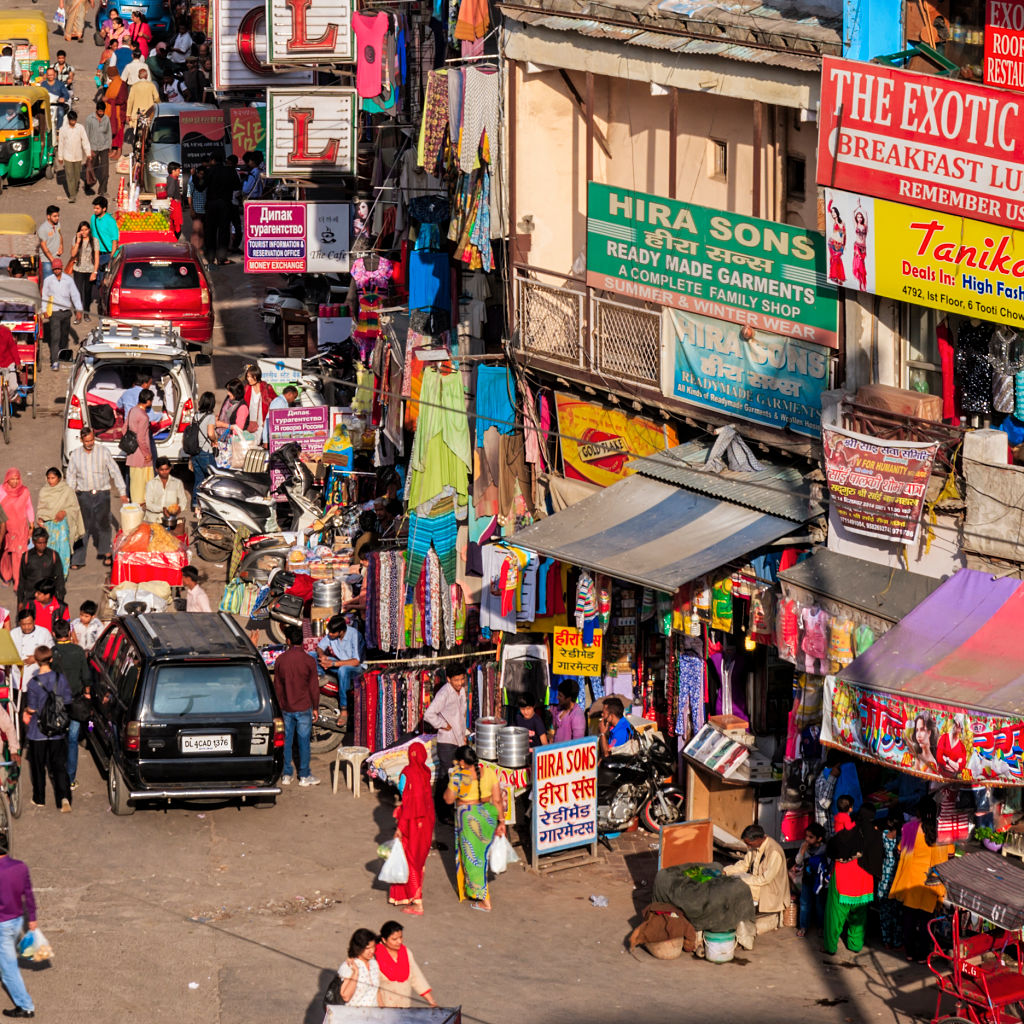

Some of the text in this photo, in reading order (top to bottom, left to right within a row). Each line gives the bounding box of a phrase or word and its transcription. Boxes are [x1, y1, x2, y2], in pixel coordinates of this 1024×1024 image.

[829, 67, 1019, 153] THE EXOTIC
[837, 132, 984, 183] BREAKFAST
[259, 207, 293, 223] Дипак
[898, 179, 1001, 218] REMEMBER
[250, 224, 303, 237] турагентство
[608, 192, 816, 261] HIRA SONS
[249, 261, 304, 269] MONEY EXCHANGE
[311, 250, 325, 260] The
[643, 228, 775, 274] हीरा सन्स
[606, 240, 816, 305] READY MADE GARMENTS
[902, 260, 936, 283] Deals
[939, 268, 956, 286] In:
[962, 273, 993, 297] High
[604, 276, 816, 340] SUMMER & WINTER WEAR
[619, 264, 801, 319] A COMPLETE FAMILY SHOP
[902, 285, 925, 301] 4792,
[940, 292, 966, 310] Floor,
[967, 299, 973, 310] 6
[975, 301, 998, 316] Tooti
[679, 316, 826, 380] HIRA SONS
[677, 383, 686, 392] All
[686, 386, 703, 398] Kinds
[703, 391, 710, 399] of
[710, 393, 743, 410] Readymade
[744, 403, 772, 419] Garments
[681, 370, 822, 418] READYMADE GARMENTS
[581, 444, 601, 458] GOLD
[862, 460, 875, 470] FOR
[877, 461, 909, 475] HUMANITY
[555, 629, 580, 646] हीरा
[184, 740, 194, 748] DL
[537, 751, 565, 780] HIRA
[566, 745, 596, 774] SONS
[538, 775, 596, 809] हीरा संस
